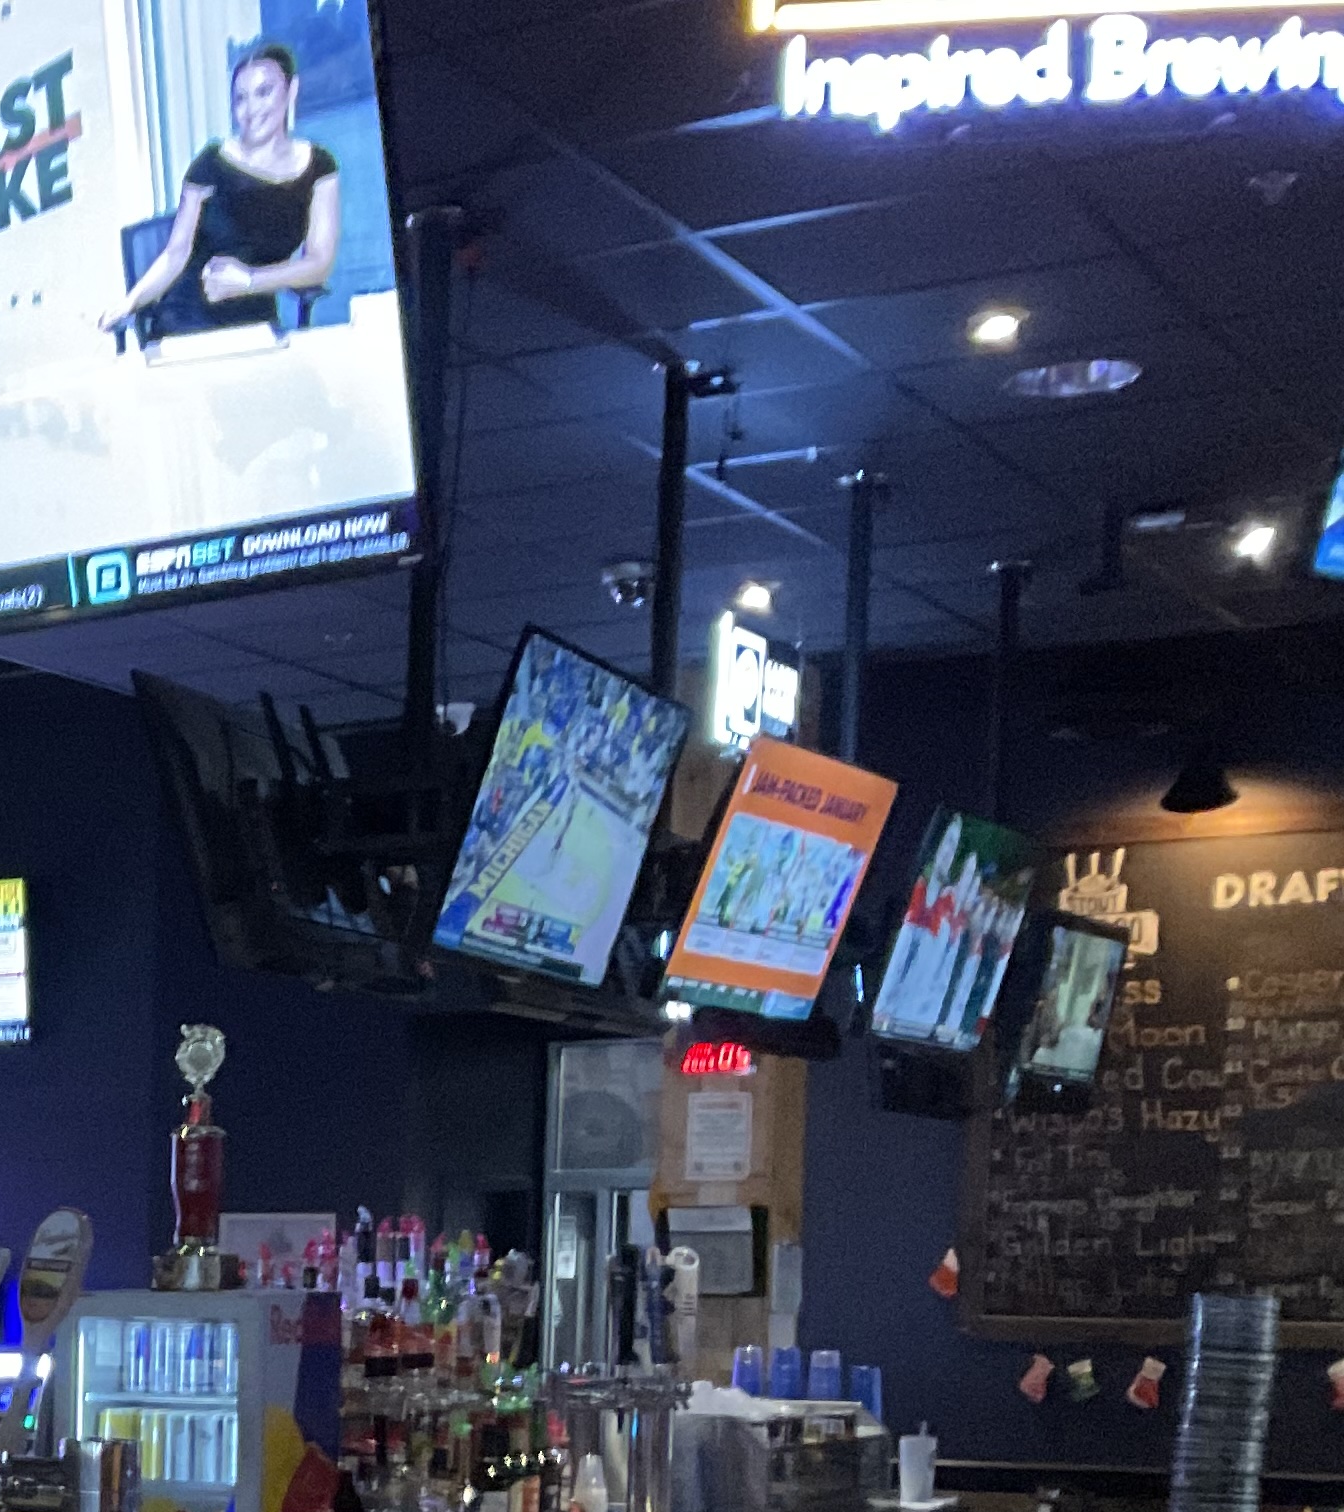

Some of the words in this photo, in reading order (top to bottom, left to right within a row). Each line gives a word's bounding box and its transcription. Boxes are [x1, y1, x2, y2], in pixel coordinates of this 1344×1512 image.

[783, 19, 1072, 134] Inspired
[1086, 15, 1344, 103] Brewin
[242, 520, 341, 558] DOWNLOAD
[752, 770, 822, 811] JAM-PACKED
[467, 799, 553, 899] MICHIGAN
